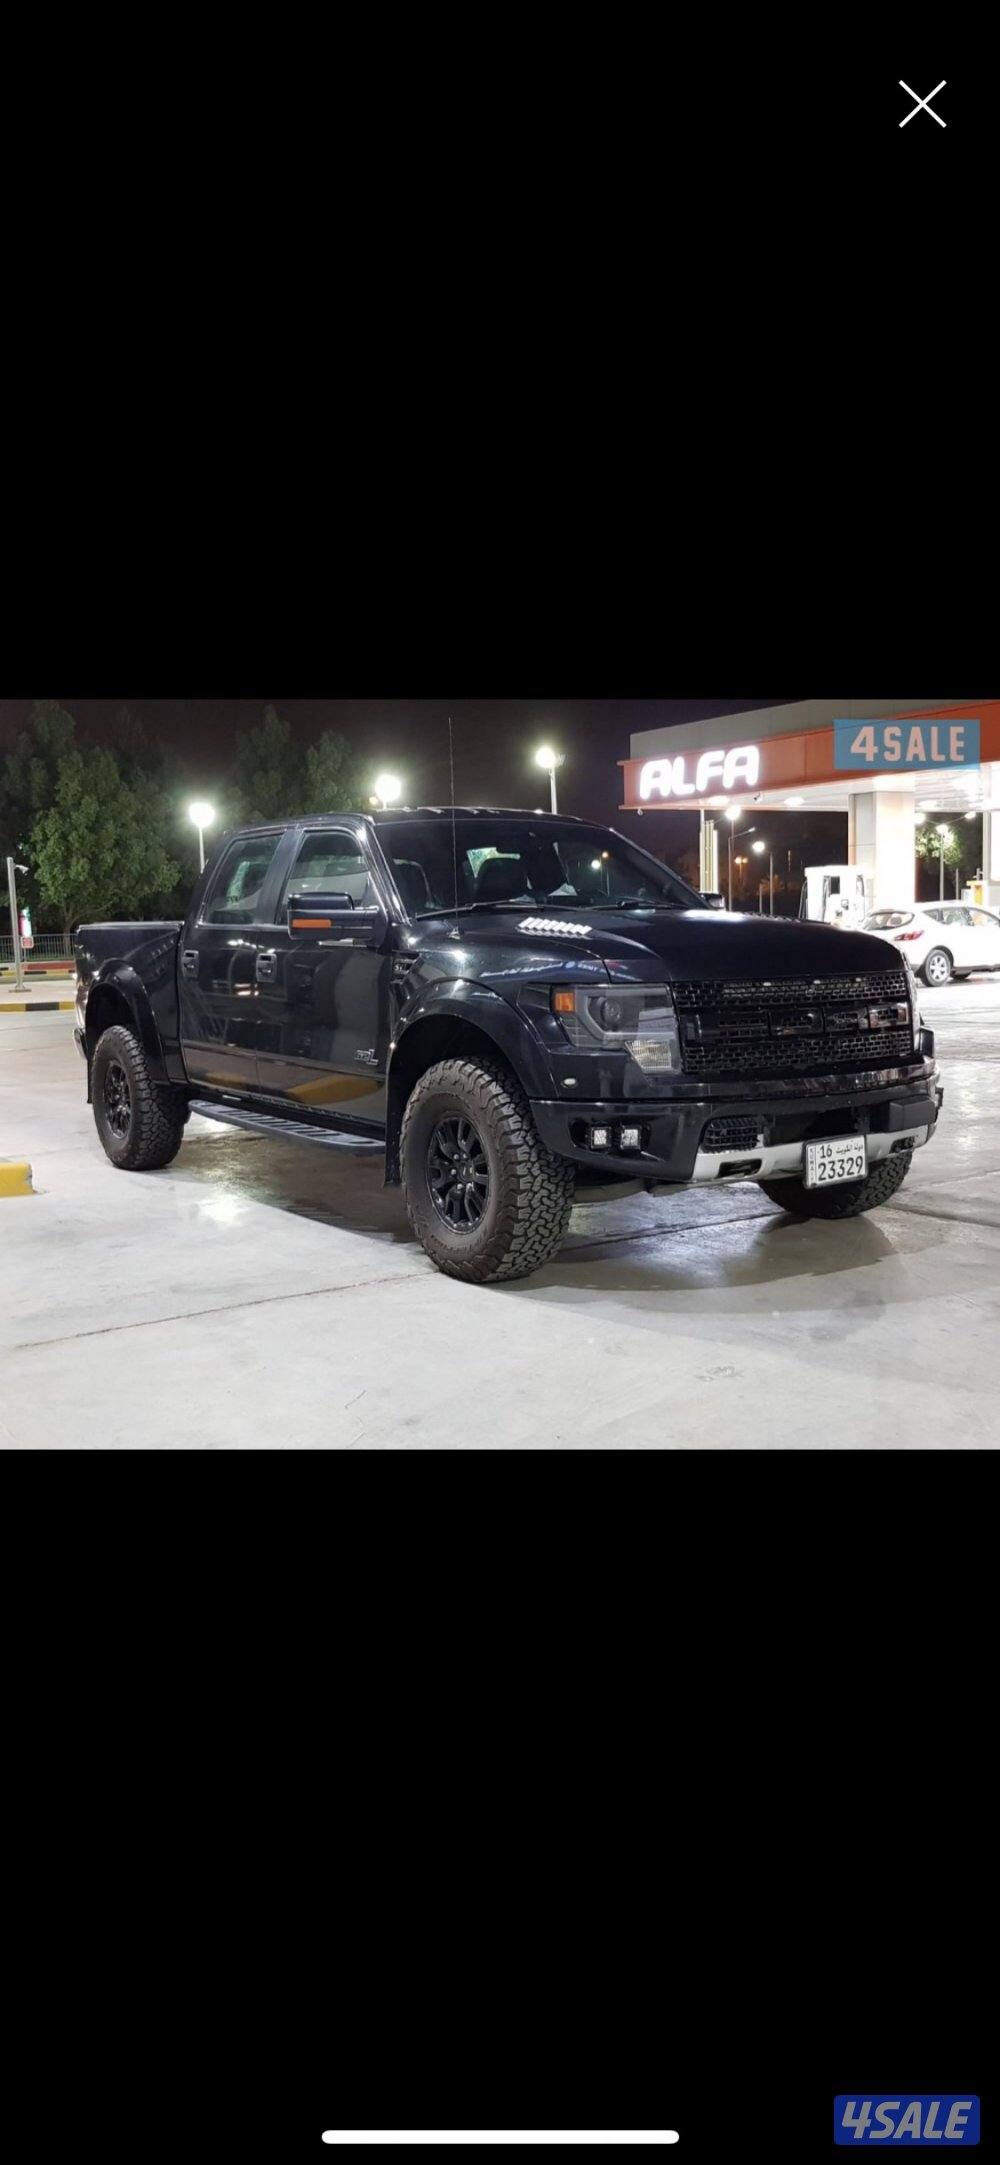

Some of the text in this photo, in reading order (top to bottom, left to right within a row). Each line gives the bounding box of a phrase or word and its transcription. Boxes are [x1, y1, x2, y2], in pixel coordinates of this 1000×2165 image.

[639, 745, 760, 800] ALFA
[819, 1145, 833, 1159] 16
[817, 1155, 864, 1182] 23329
